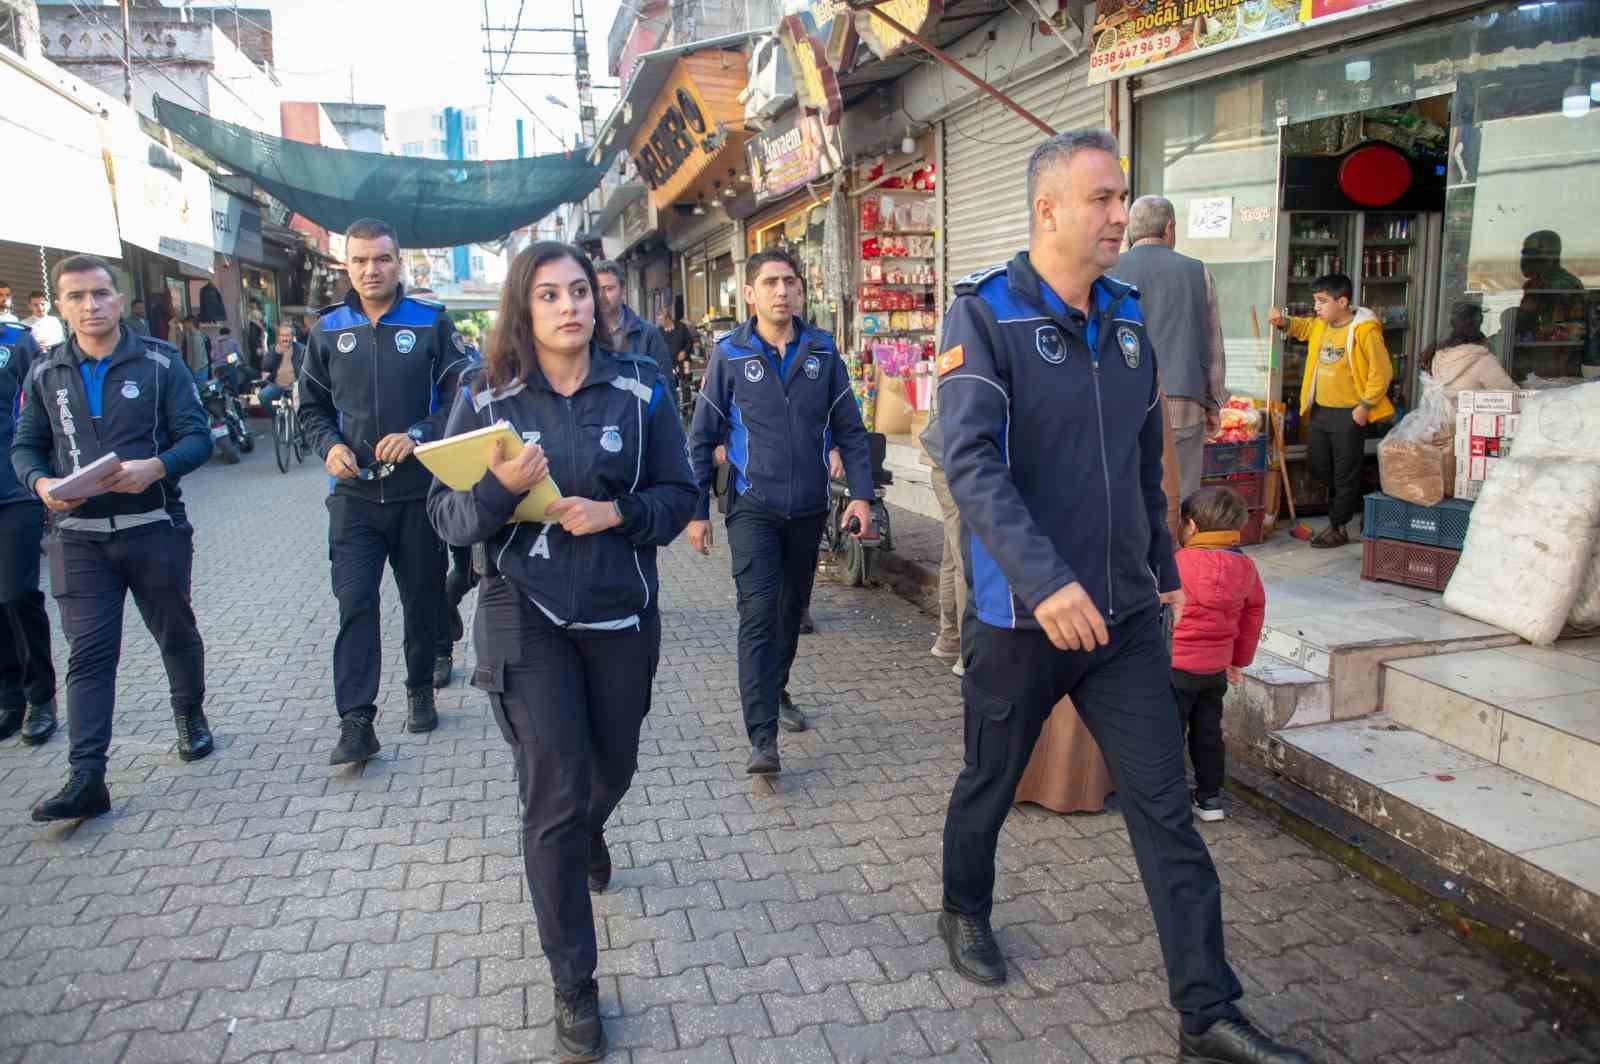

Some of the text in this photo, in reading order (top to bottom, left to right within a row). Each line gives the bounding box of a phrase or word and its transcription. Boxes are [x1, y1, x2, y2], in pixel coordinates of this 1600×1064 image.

[1135, 5, 1180, 33] DOĞAL
[1091, 51, 1116, 68] 0538
[1119, 45, 1137, 60] 447
[1157, 36, 1171, 49] 39
